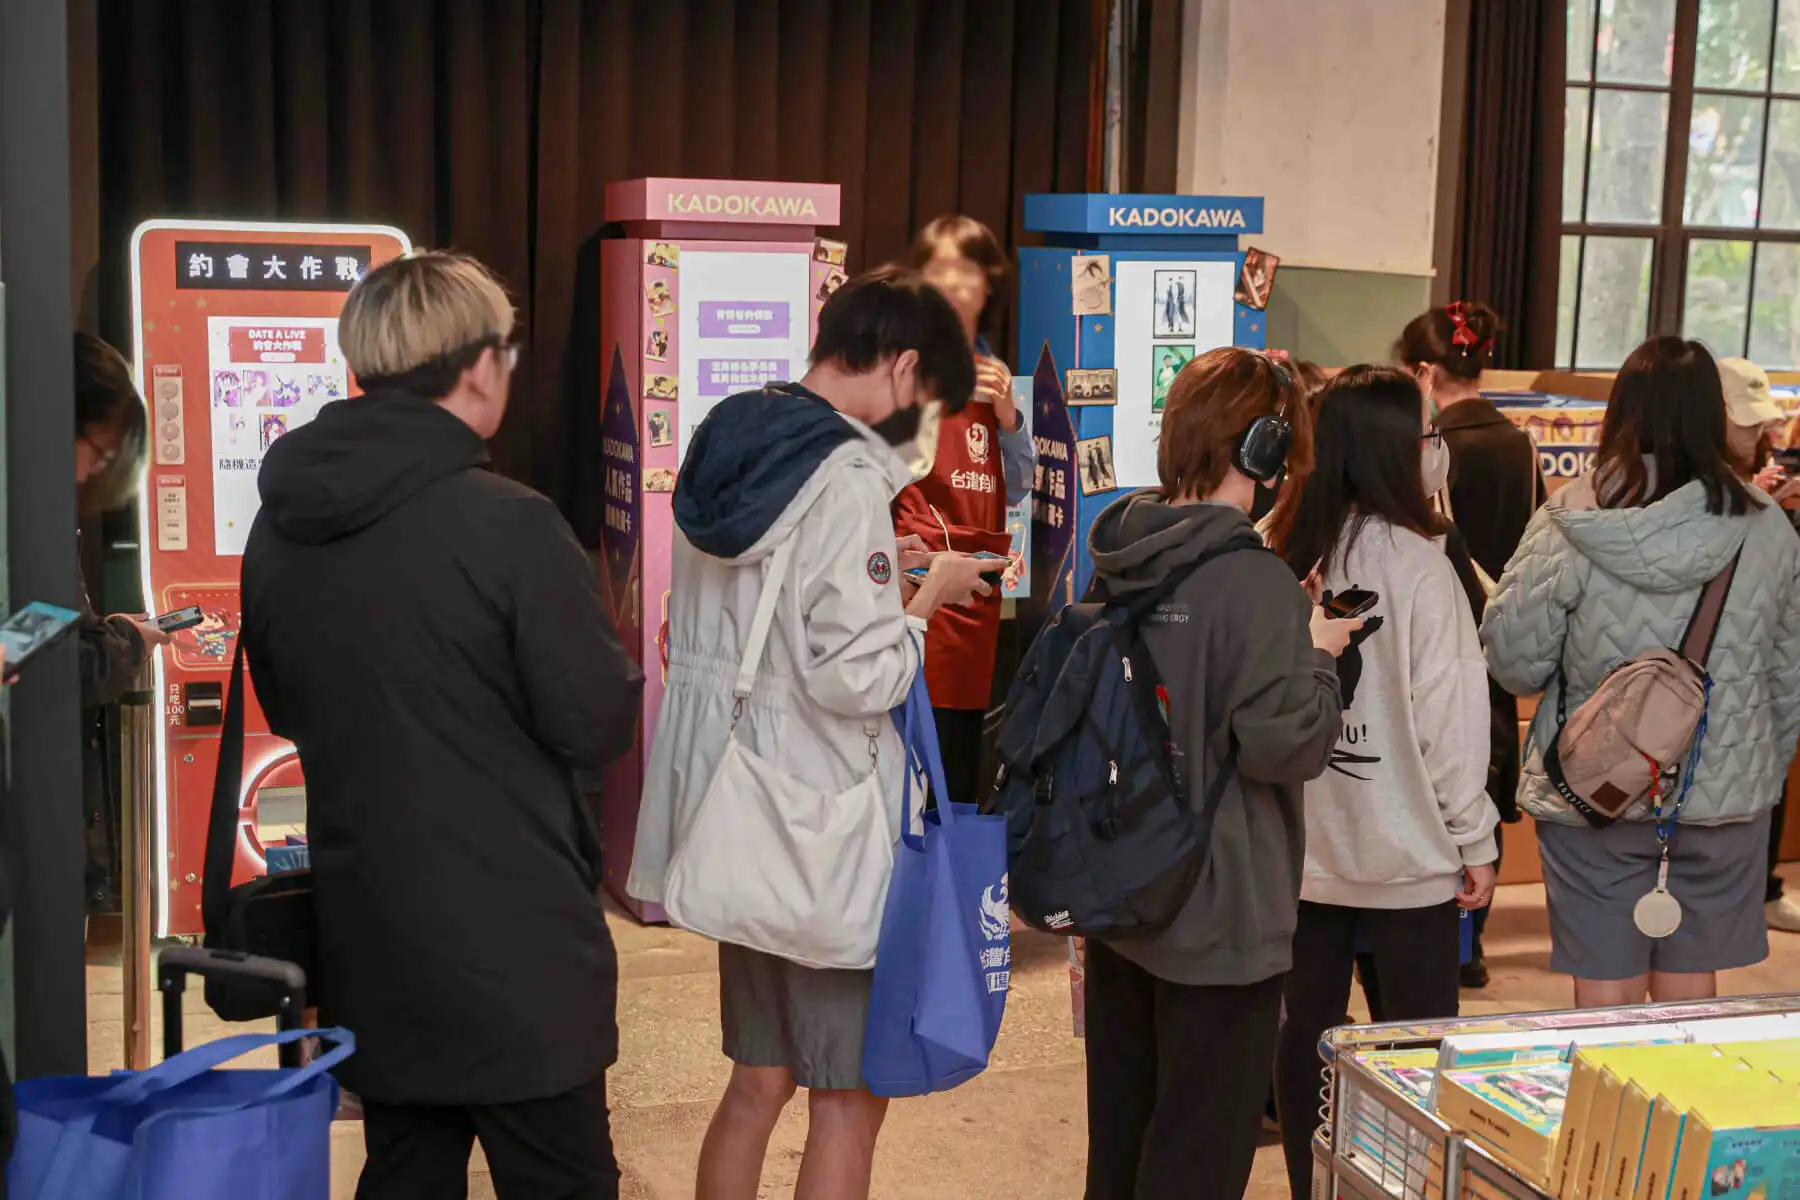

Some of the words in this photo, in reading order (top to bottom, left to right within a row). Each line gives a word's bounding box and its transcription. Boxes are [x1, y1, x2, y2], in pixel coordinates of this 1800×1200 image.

[668, 192, 818, 217] KADOKAWA
[1108, 206, 1246, 229] KADOKAWA
[188, 252, 361, 281] 約會大作戰
[275, 329, 284, 340] A
